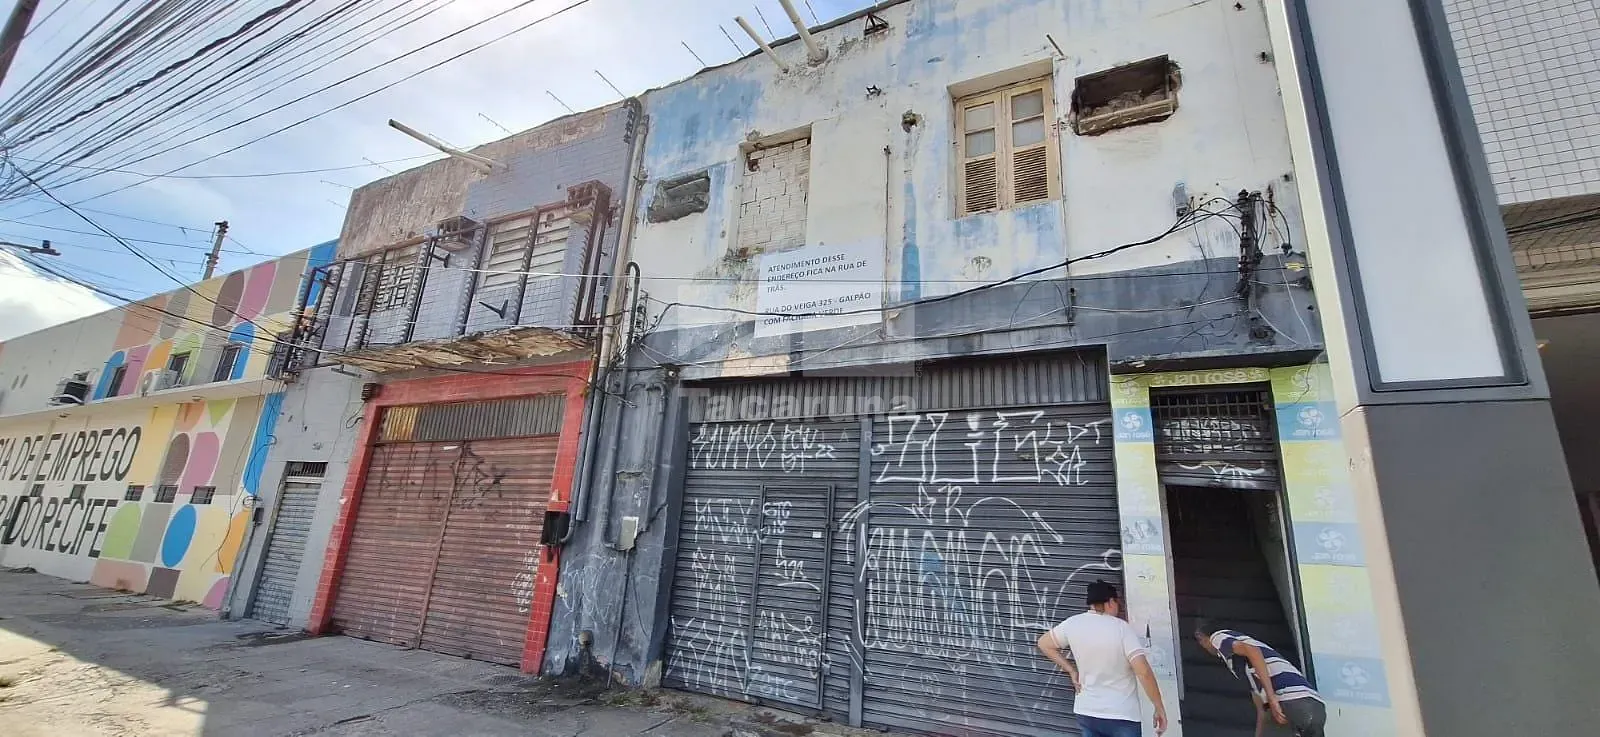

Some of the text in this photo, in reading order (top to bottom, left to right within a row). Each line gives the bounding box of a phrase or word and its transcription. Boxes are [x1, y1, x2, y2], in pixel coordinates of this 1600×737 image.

[767, 260, 868, 283] ENDEREÇO FICA NA RUA DE
[768, 253, 845, 273] ATENDIMENTO DESSE
[781, 304, 793, 312] DO
[794, 300, 818, 311] VEIGA
[819, 298, 833, 307] 325
[839, 292, 872, 303] GALPÃO
[764, 316, 781, 326] COM
[9, 435, 44, 481] DE
[34, 426, 142, 481] EMPREGO
[32, 496, 119, 559] RECIFE
